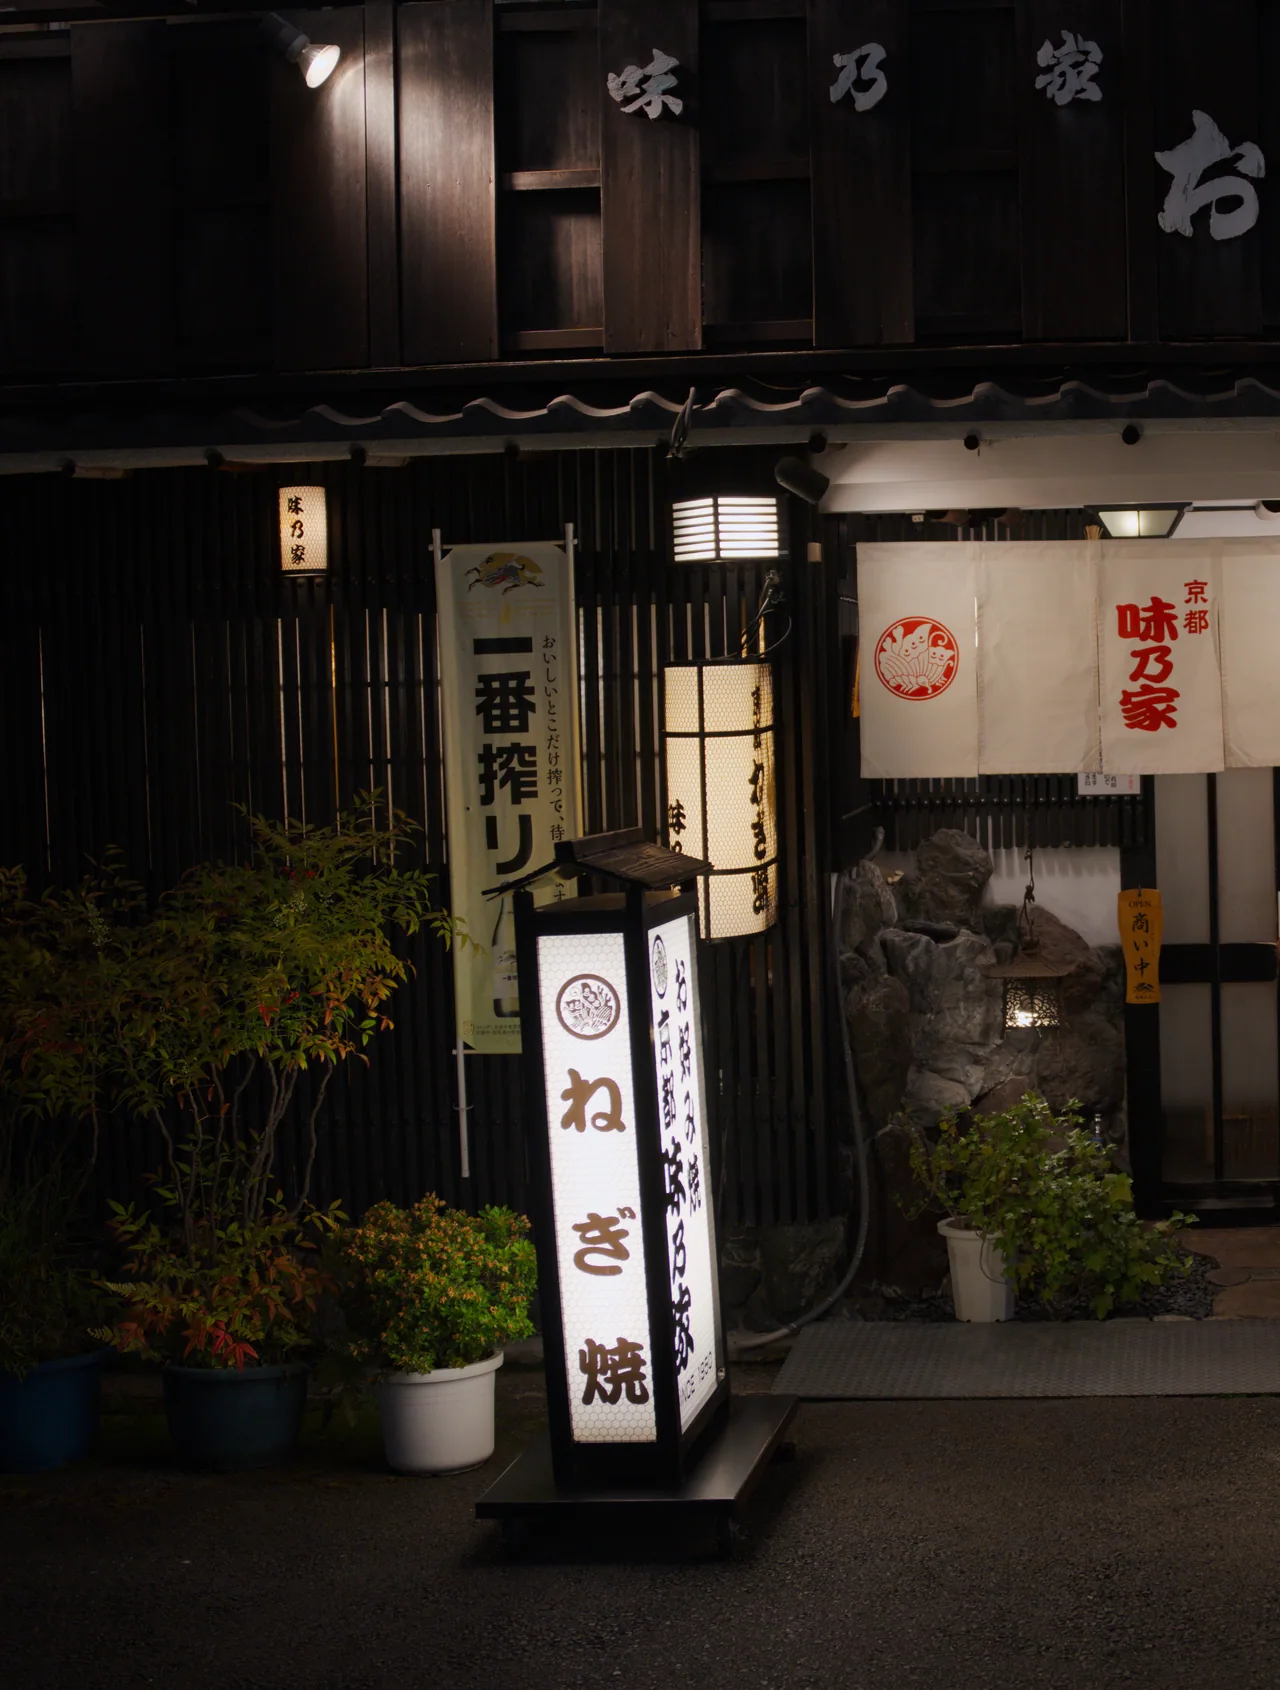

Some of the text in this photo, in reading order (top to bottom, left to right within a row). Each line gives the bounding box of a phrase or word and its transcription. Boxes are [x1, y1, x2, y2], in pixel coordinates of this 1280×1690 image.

[606, 30, 1103, 120] 味乃家
[287, 495, 306, 566] 味乃家
[1183, 579, 1209, 635] 京都
[1116, 596, 1181, 732] 味乃家
[473, 636, 539, 876] 一番搾り
[1128, 900, 1152, 908] OPEN
[1132, 912, 1150, 978] 商い中
[675, 957, 701, 1217] お好み焼
[560, 1068, 650, 1406] ねぎ焼
